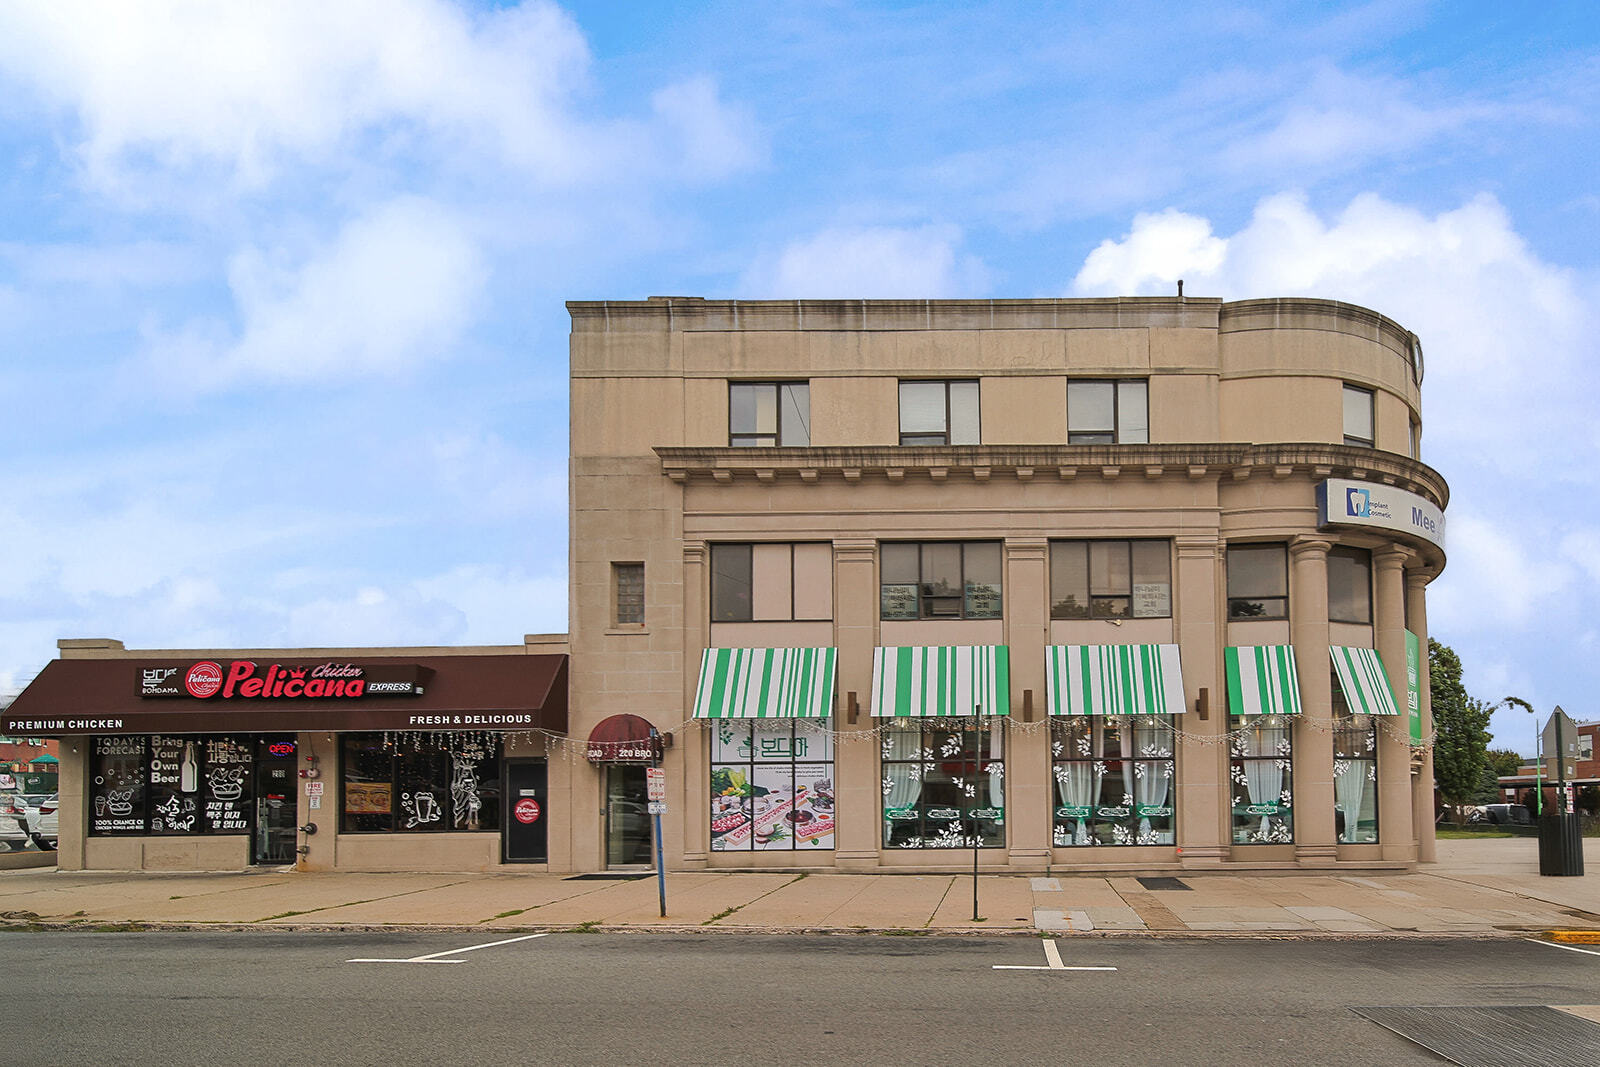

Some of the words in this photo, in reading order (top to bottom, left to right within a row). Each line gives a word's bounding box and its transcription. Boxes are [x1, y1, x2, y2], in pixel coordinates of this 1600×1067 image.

[311, 662, 363, 678] Chicken
[222, 661, 365, 698] Pelicana
[369, 682, 411, 691] EXPRESS
[9, 720, 65, 730] PREMIUM
[68, 719, 123, 729] CHICKEN
[409, 715, 450, 725] FRESH
[453, 715, 462, 724] &
[464, 714, 532, 724] DELICIOUS
[151, 735, 183, 748] Bring
[96, 746, 145, 755] FORECAST
[151, 747, 179, 758] Your
[268, 744, 294, 754] OPEN
[150, 759, 179, 771] Own
[150, 772, 180, 783] Beer
